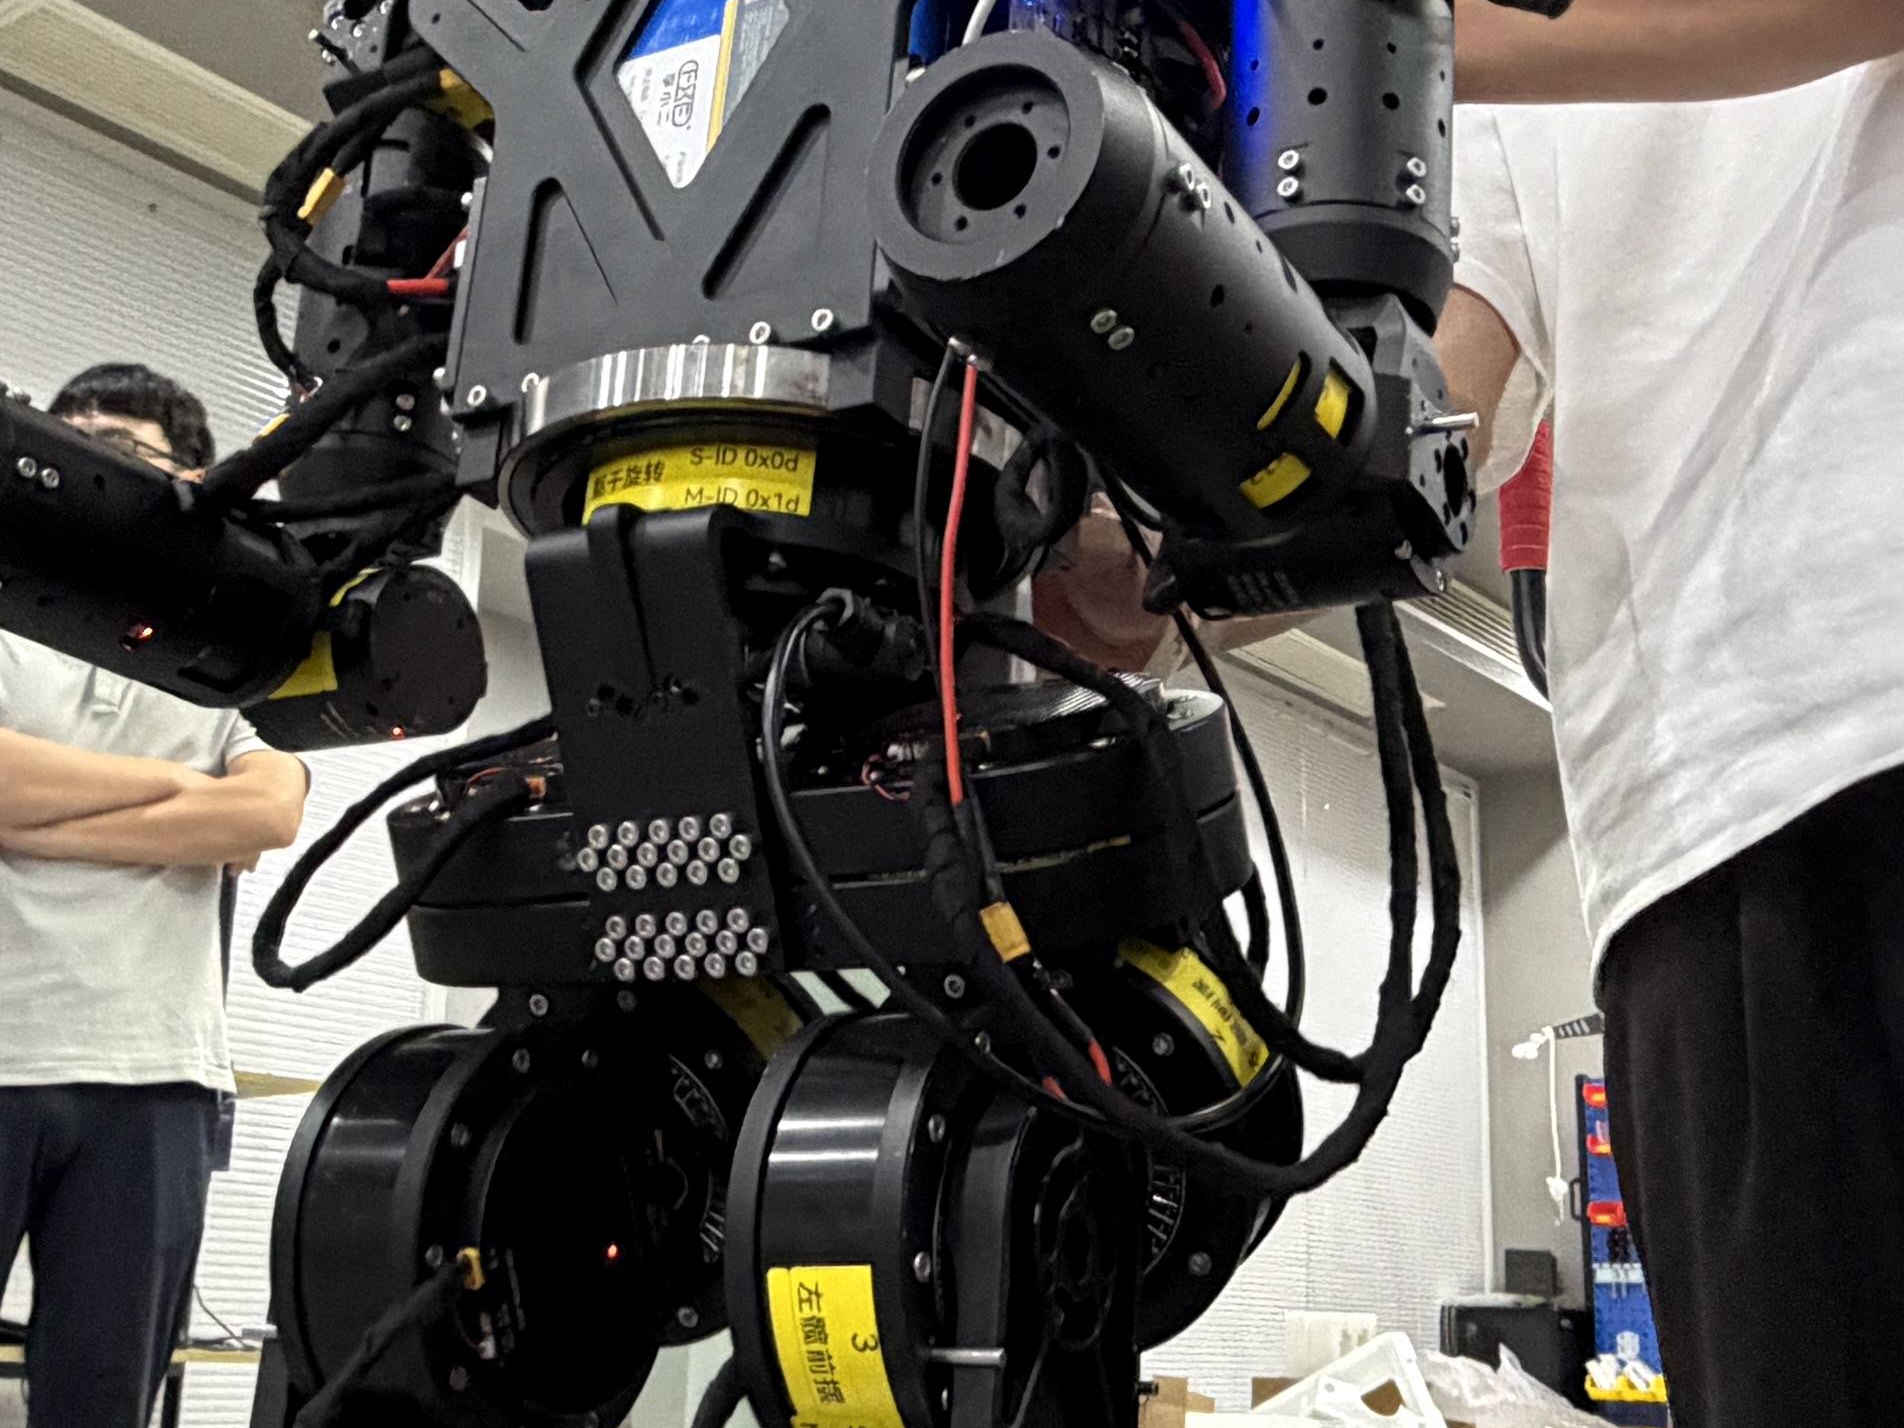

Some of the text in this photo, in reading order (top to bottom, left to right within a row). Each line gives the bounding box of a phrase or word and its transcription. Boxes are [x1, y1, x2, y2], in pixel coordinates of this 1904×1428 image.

[690, 443, 800, 472] S-ID 0x0d
[685, 485, 800, 513] M-ID 0x1d
[851, 1333, 879, 1353] 3
